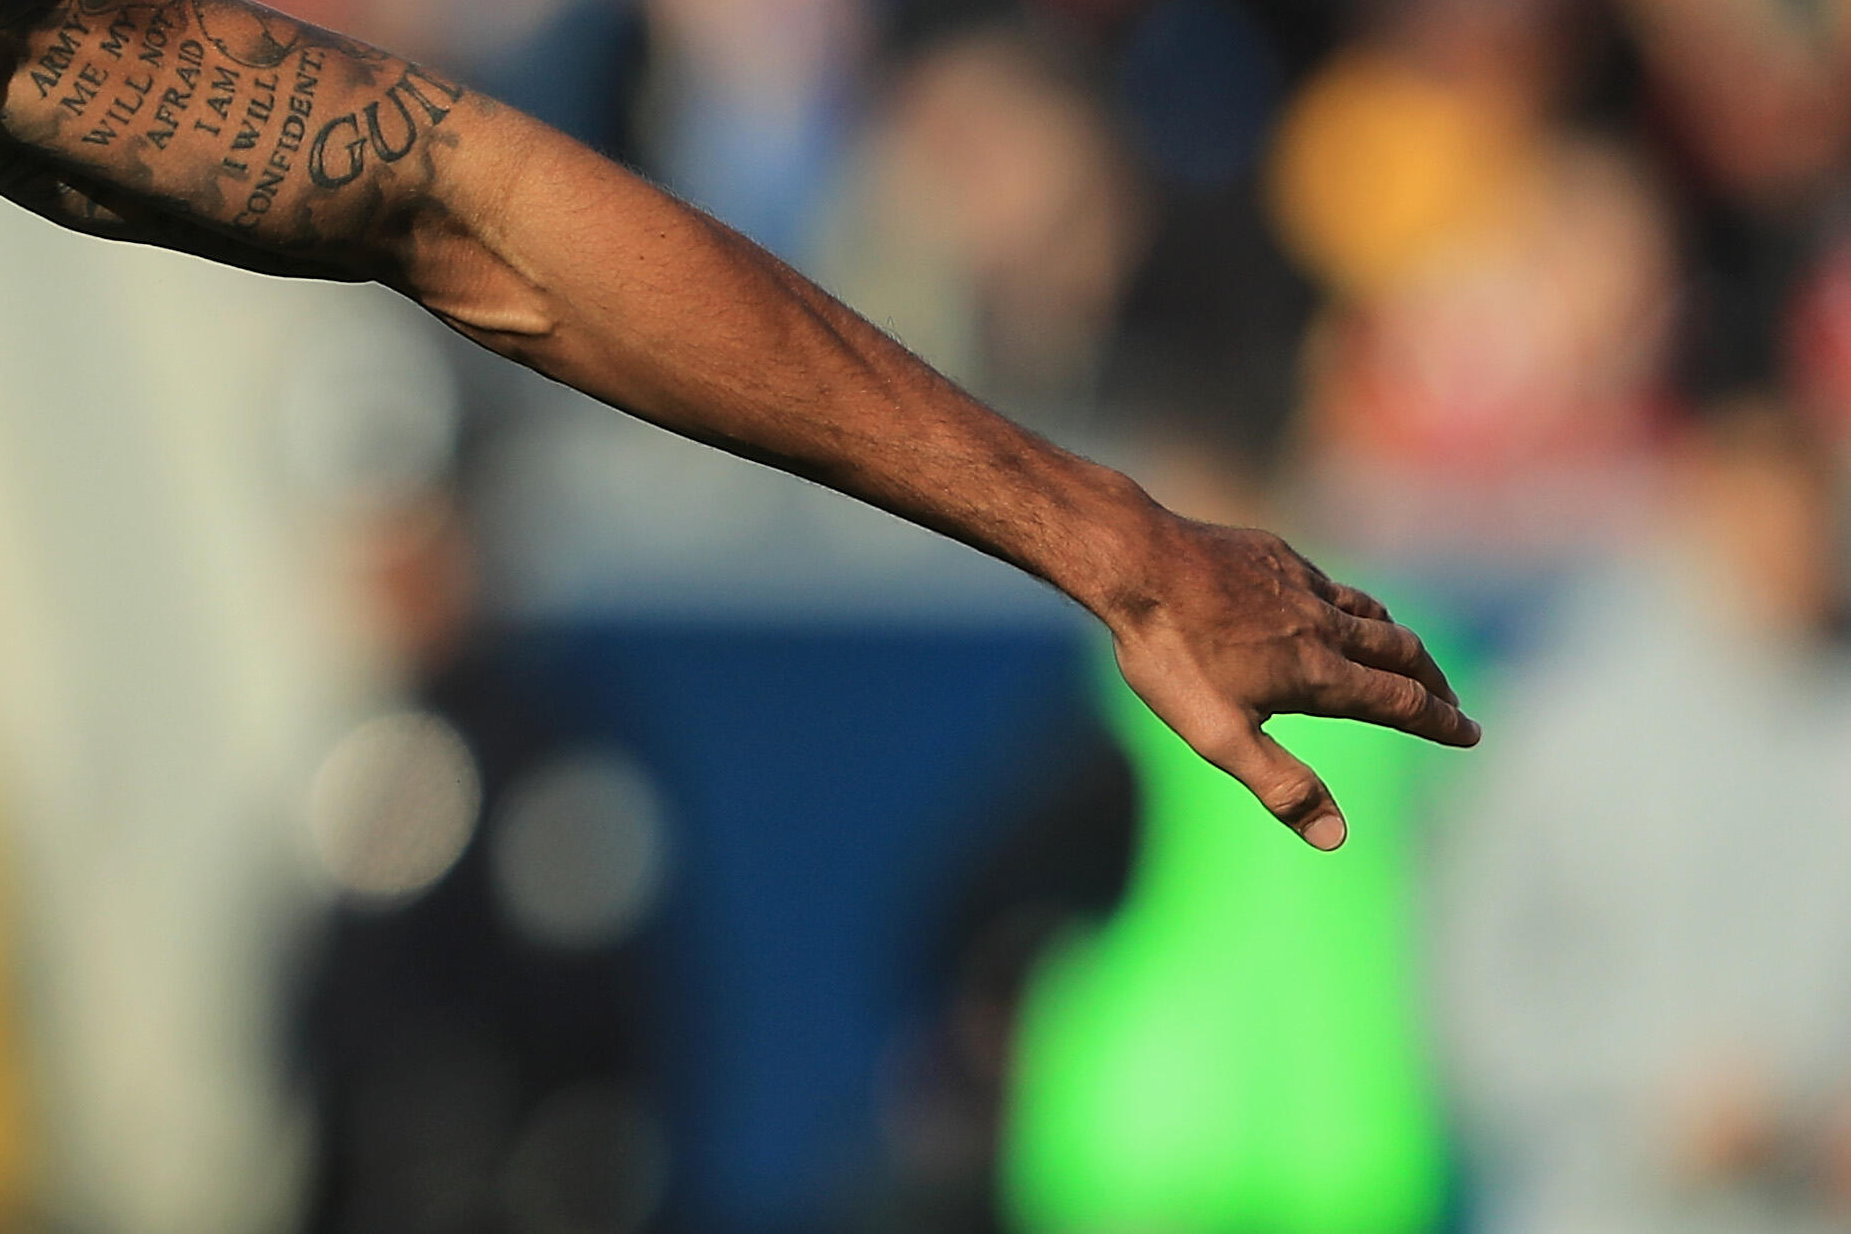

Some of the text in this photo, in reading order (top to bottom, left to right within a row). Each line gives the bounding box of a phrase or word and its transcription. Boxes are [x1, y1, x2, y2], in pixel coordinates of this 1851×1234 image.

[30, 14, 89, 98] ARMY
[60, 9, 137, 116] ME MY
[81, 8, 174, 145] WILL NOT
[146, 39, 205, 150] AFRAID
[194, 65, 240, 136] I AM
[222, 72, 279, 173] I WILL
